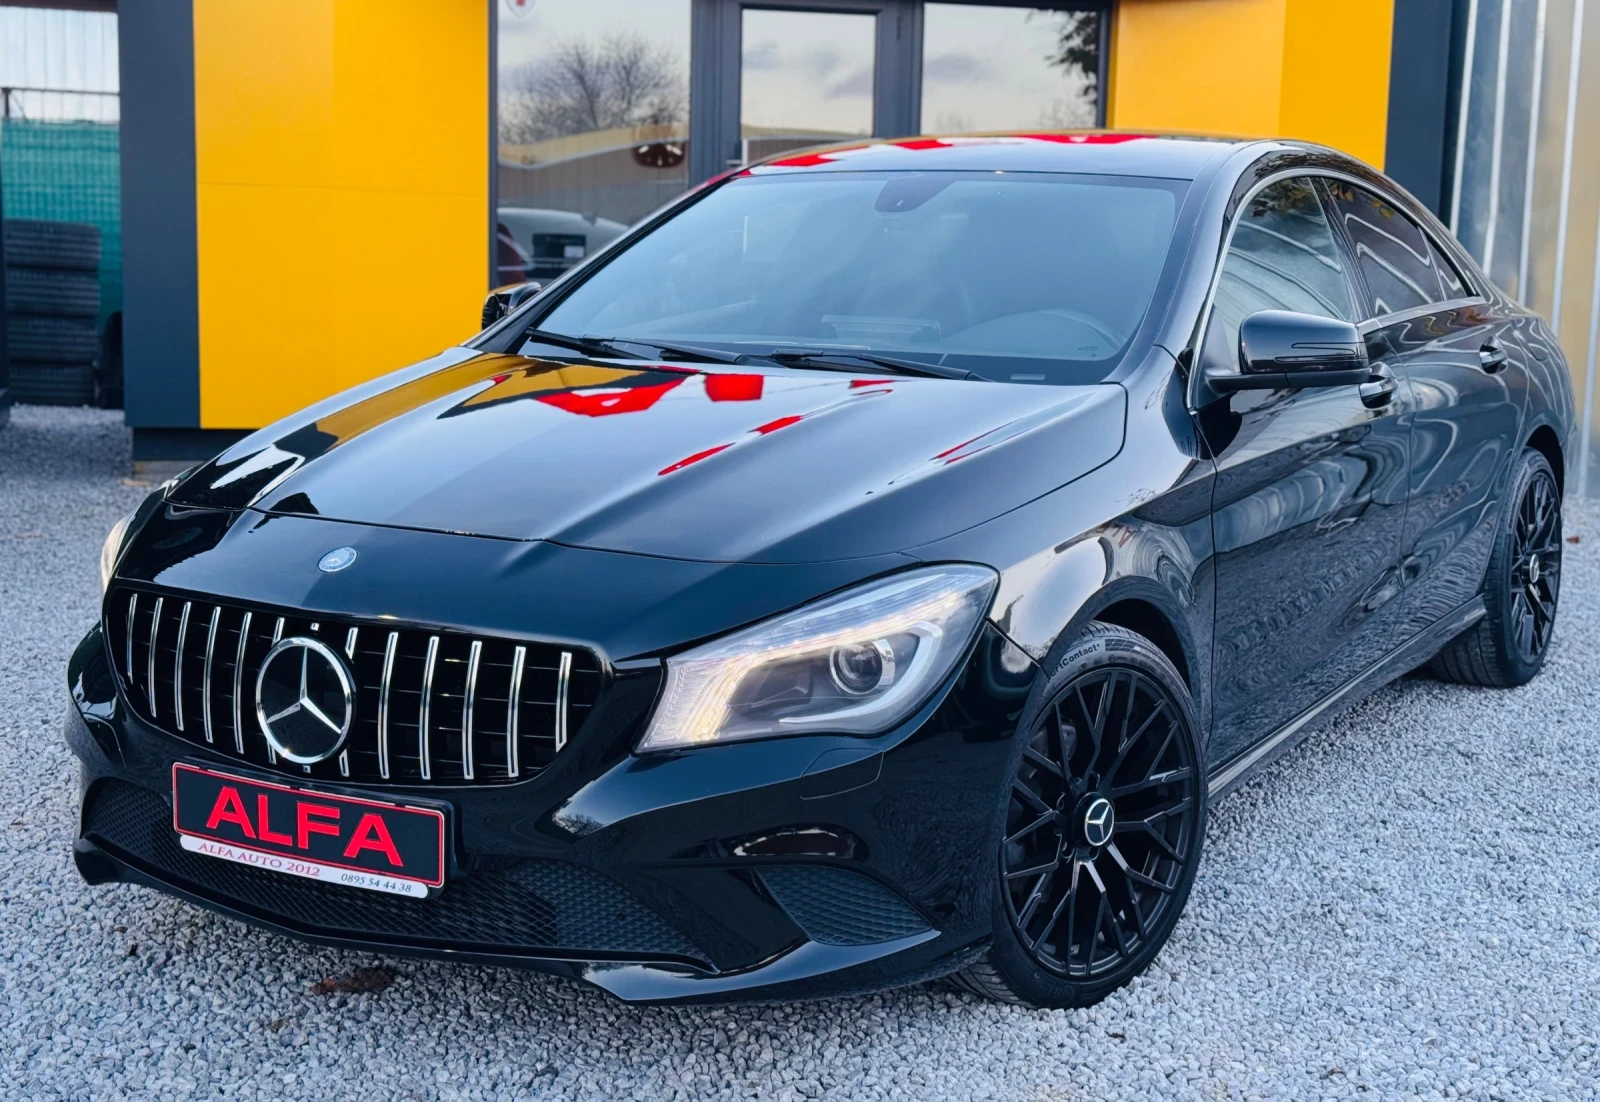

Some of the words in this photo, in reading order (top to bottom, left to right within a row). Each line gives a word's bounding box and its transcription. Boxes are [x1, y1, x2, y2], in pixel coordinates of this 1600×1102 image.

[206, 786, 404, 867] ALFA
[198, 842, 235, 859] ALFA
[237, 852, 283, 869] AUTO
[286, 861, 321, 877] 2012
[341, 873, 366, 885] 0895
[367, 878, 381, 887] 54
[383, 881, 397, 890] 44
[398, 883, 412, 893] 38
